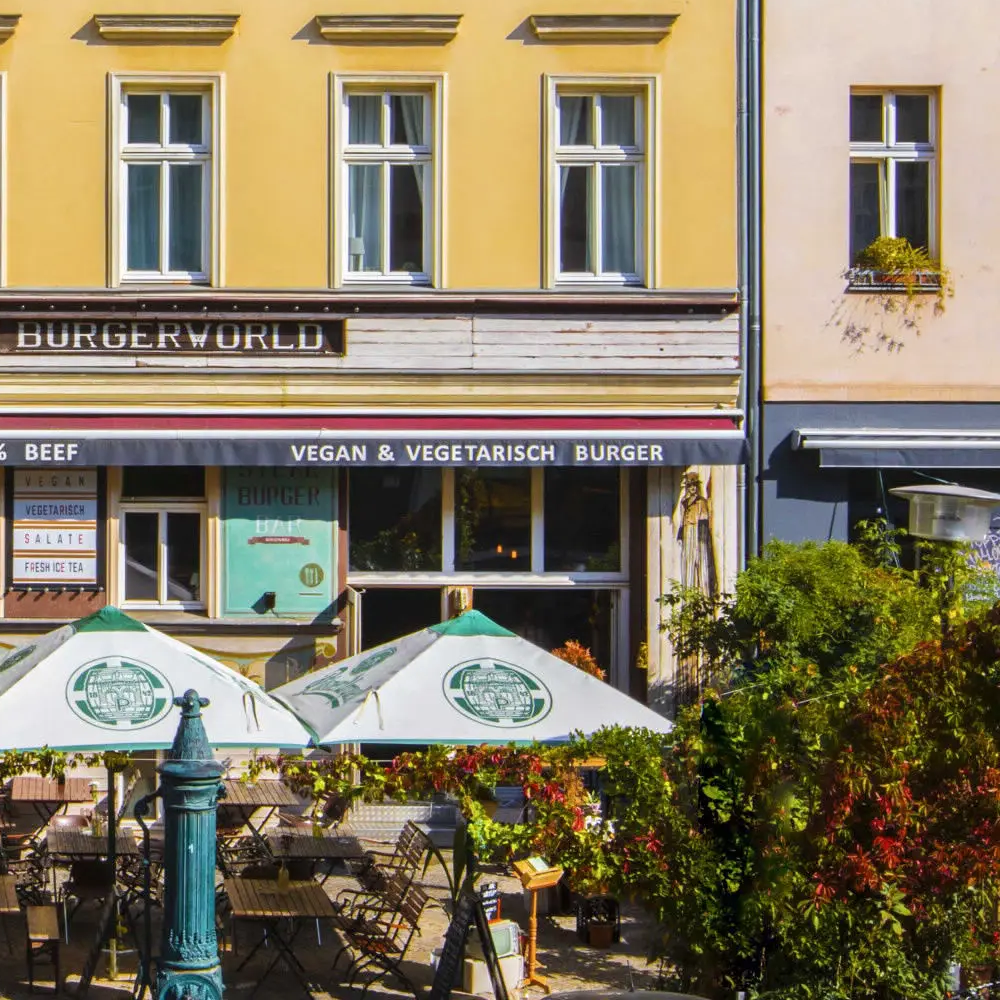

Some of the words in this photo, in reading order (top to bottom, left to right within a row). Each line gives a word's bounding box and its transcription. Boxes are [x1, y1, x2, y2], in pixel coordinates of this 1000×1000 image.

[16, 321, 324, 350] BURGERWORLD
[25, 443, 79, 462] BEEF
[291, 444, 367, 462] VEGAN
[378, 444, 396, 462] &
[406, 444, 555, 462] VEGETARISCH
[576, 444, 664, 462] BURGER
[25, 475, 85, 488] VEGAN
[238, 486, 320, 506] BURGER
[25, 504, 85, 516] VEGETARISCH
[255, 514, 302, 534] BAR
[24, 533, 83, 545] SALATE
[25, 562, 50, 573] FRESH
[53, 562, 65, 573] ICE
[68, 562, 84, 573] TEA
